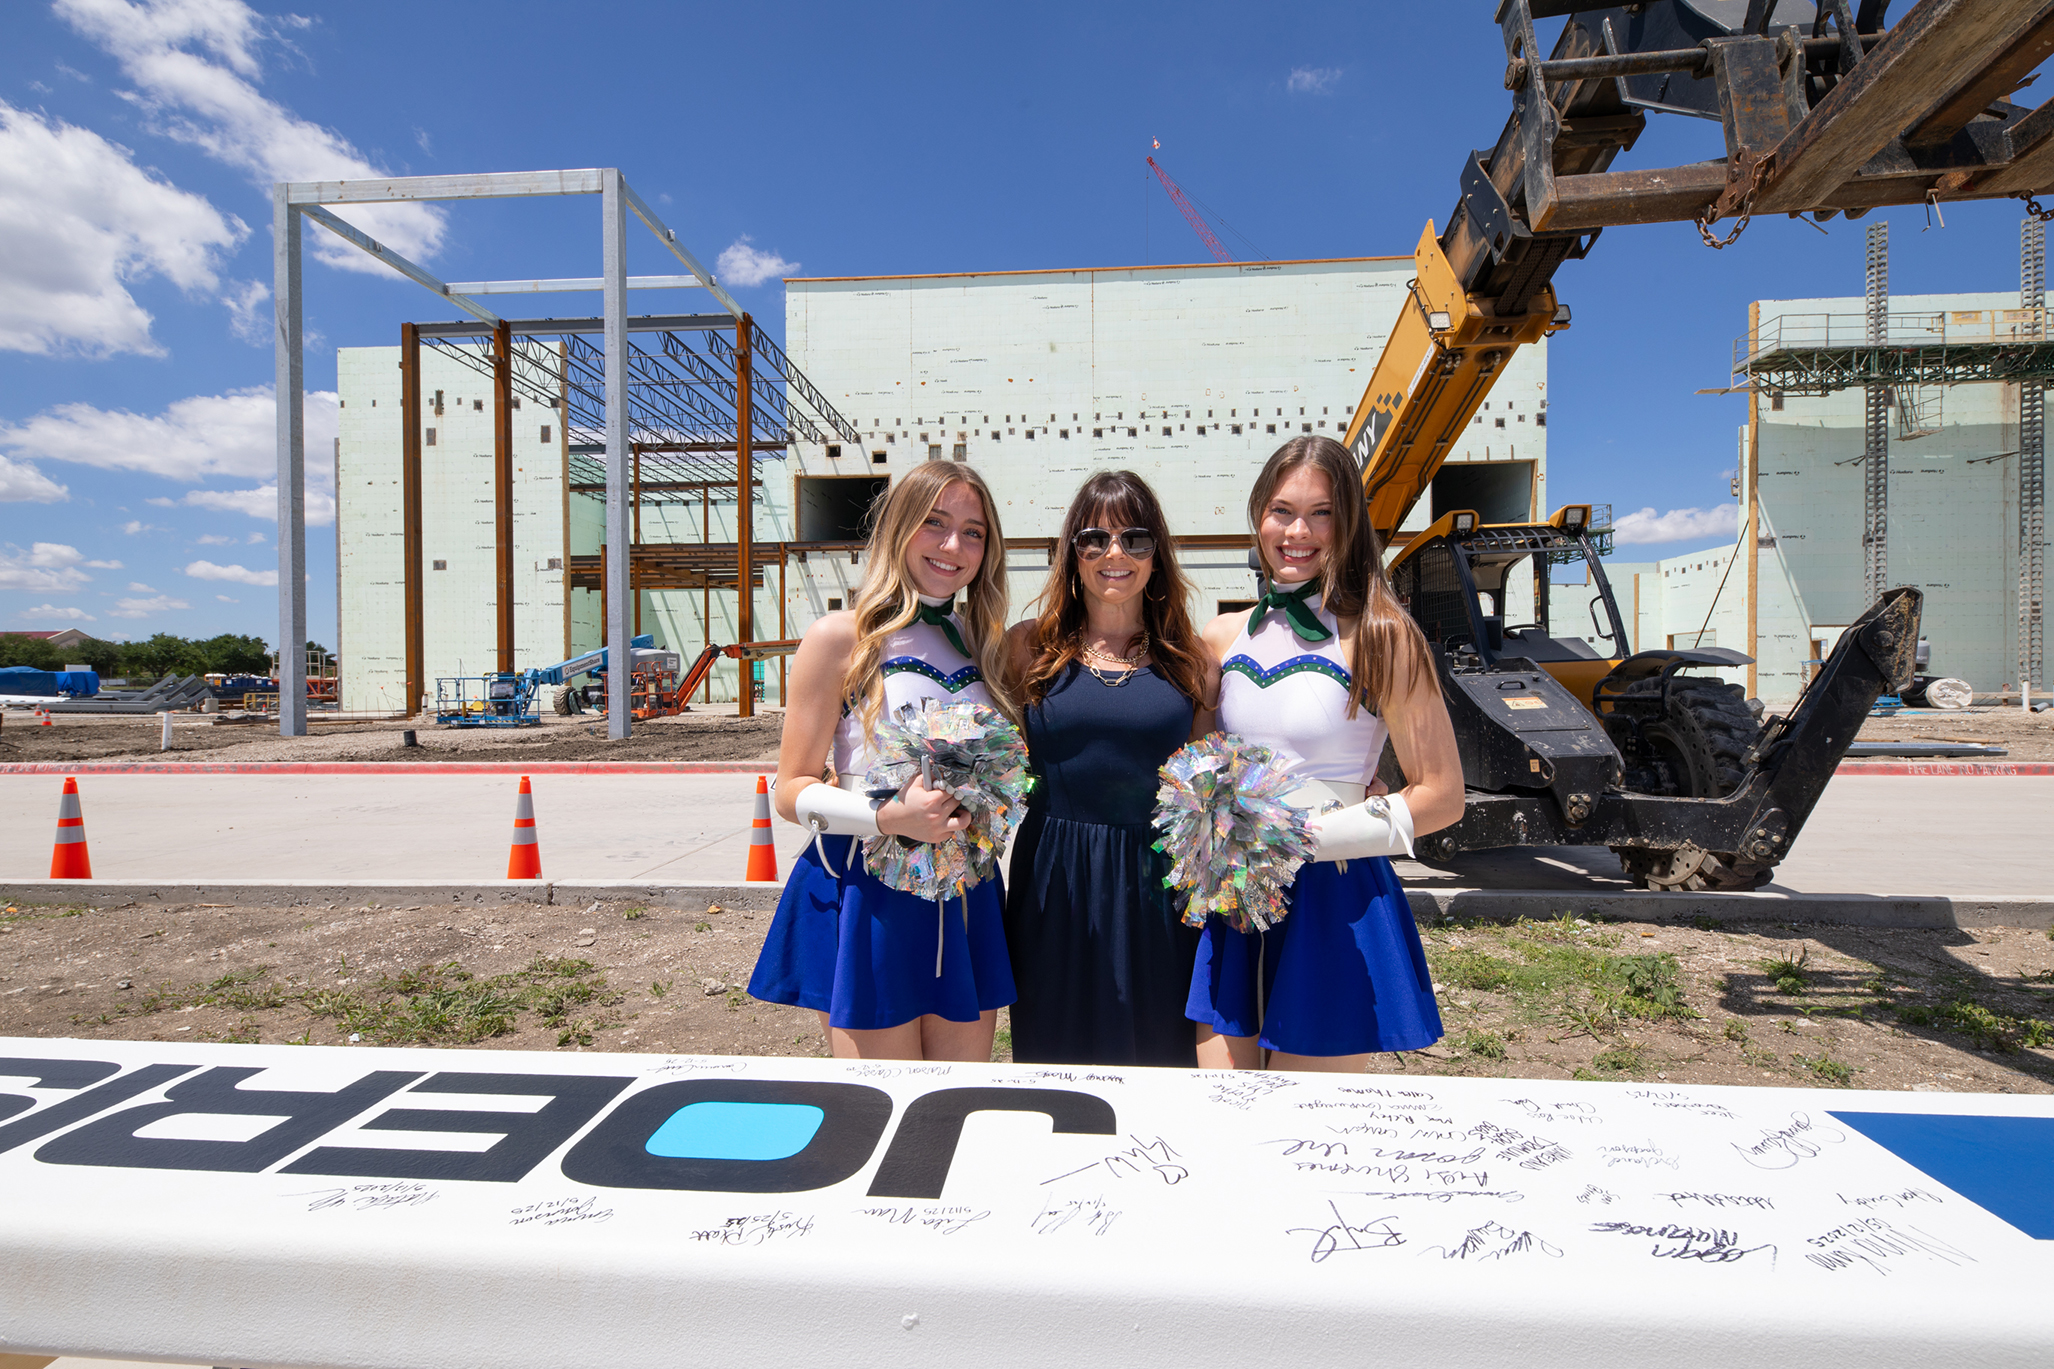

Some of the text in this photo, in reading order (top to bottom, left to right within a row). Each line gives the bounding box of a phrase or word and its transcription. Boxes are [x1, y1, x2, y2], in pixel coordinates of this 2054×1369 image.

[1353, 411, 1377, 470] NY
[1908, 764, 1929, 775] FIRE
[1930, 764, 1956, 775] LANE
[1338, 1087, 1395, 1097] Thomas
